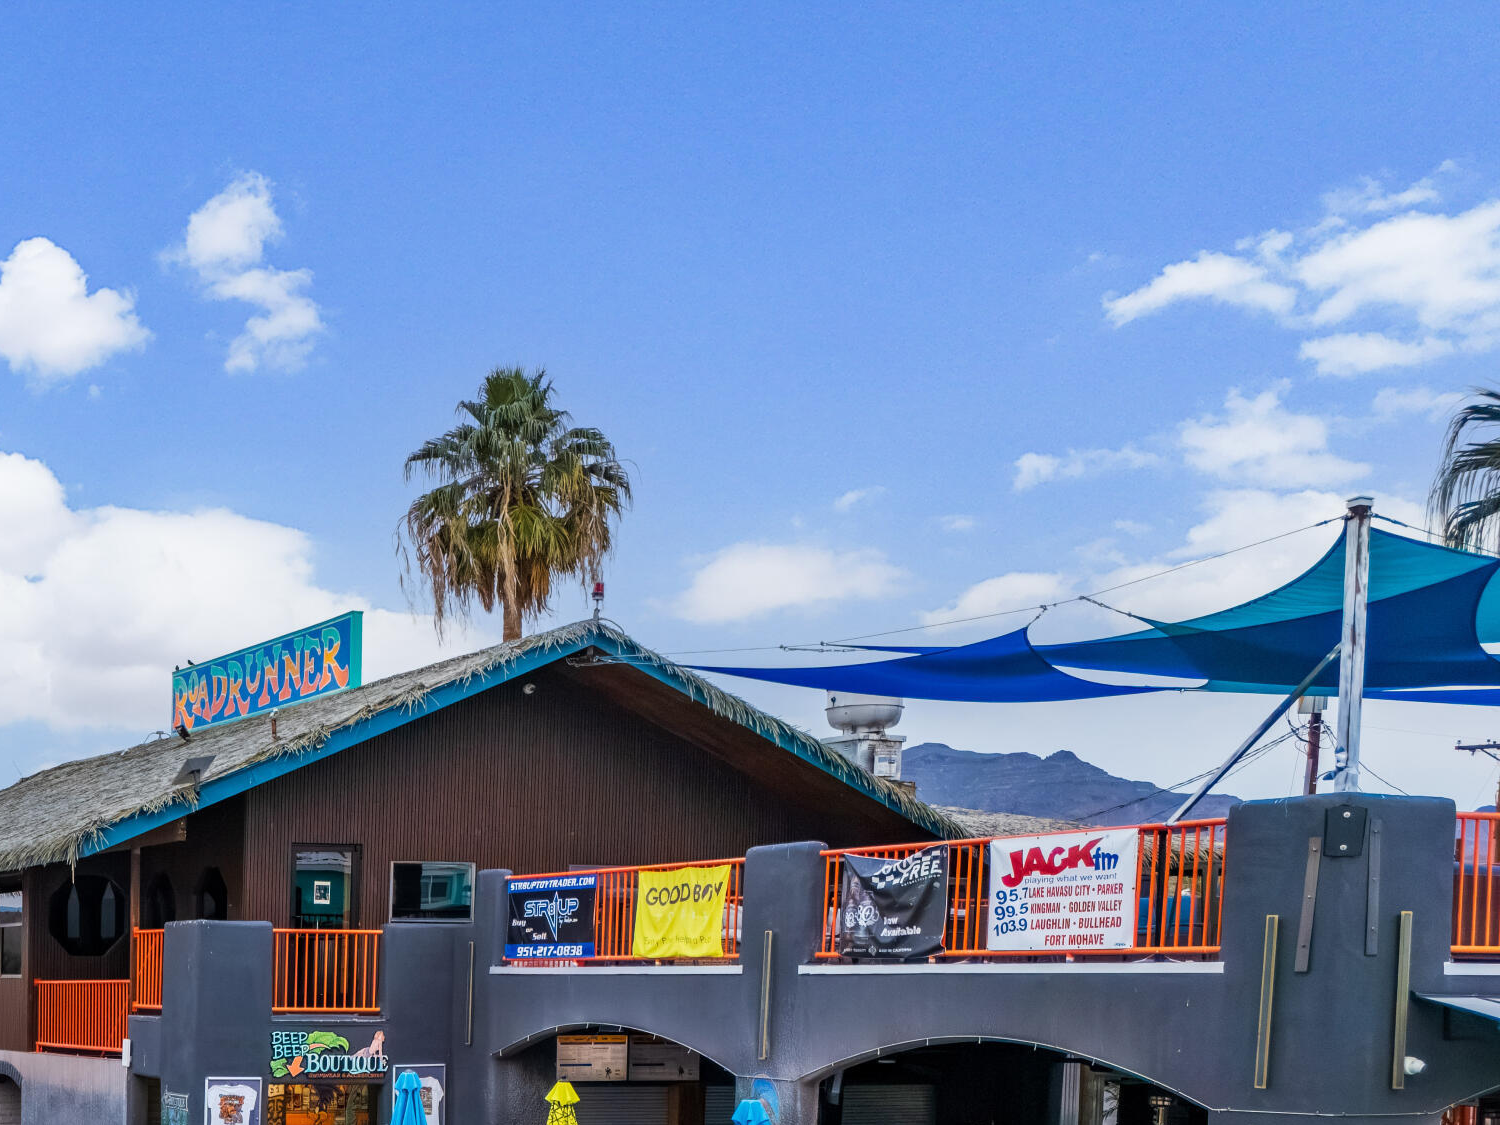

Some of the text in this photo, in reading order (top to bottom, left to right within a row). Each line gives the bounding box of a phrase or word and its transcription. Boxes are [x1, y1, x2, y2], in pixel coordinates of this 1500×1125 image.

[172, 626, 349, 730] ROADRUNNER
[1001, 837, 1119, 888] JACK fm
[510, 876, 595, 891] STR8UPTOYTRADER.COM
[1024, 877, 1054, 885] playing
[1057, 874, 1077, 882] what
[645, 883, 691, 907] GOOD
[995, 887, 1029, 905] 95.7
[1028, 883, 1123, 899] LAKE HAVASU CITY PARKER
[994, 903, 1029, 921] 99.5
[1030, 900, 1122, 914] KINGMAN GOLDEN VALLEY
[993, 918, 1027, 937] 103.9
[1030, 916, 1122, 930] LAUGHLIN BULLHEAD
[1044, 935, 1067, 946] FORT
[1068, 934, 1104, 945] MOHAVE
[517, 945, 583, 957] 951-217-0838
[271, 1031, 308, 1045] BEEP
[272, 1044, 310, 1059] BEEP
